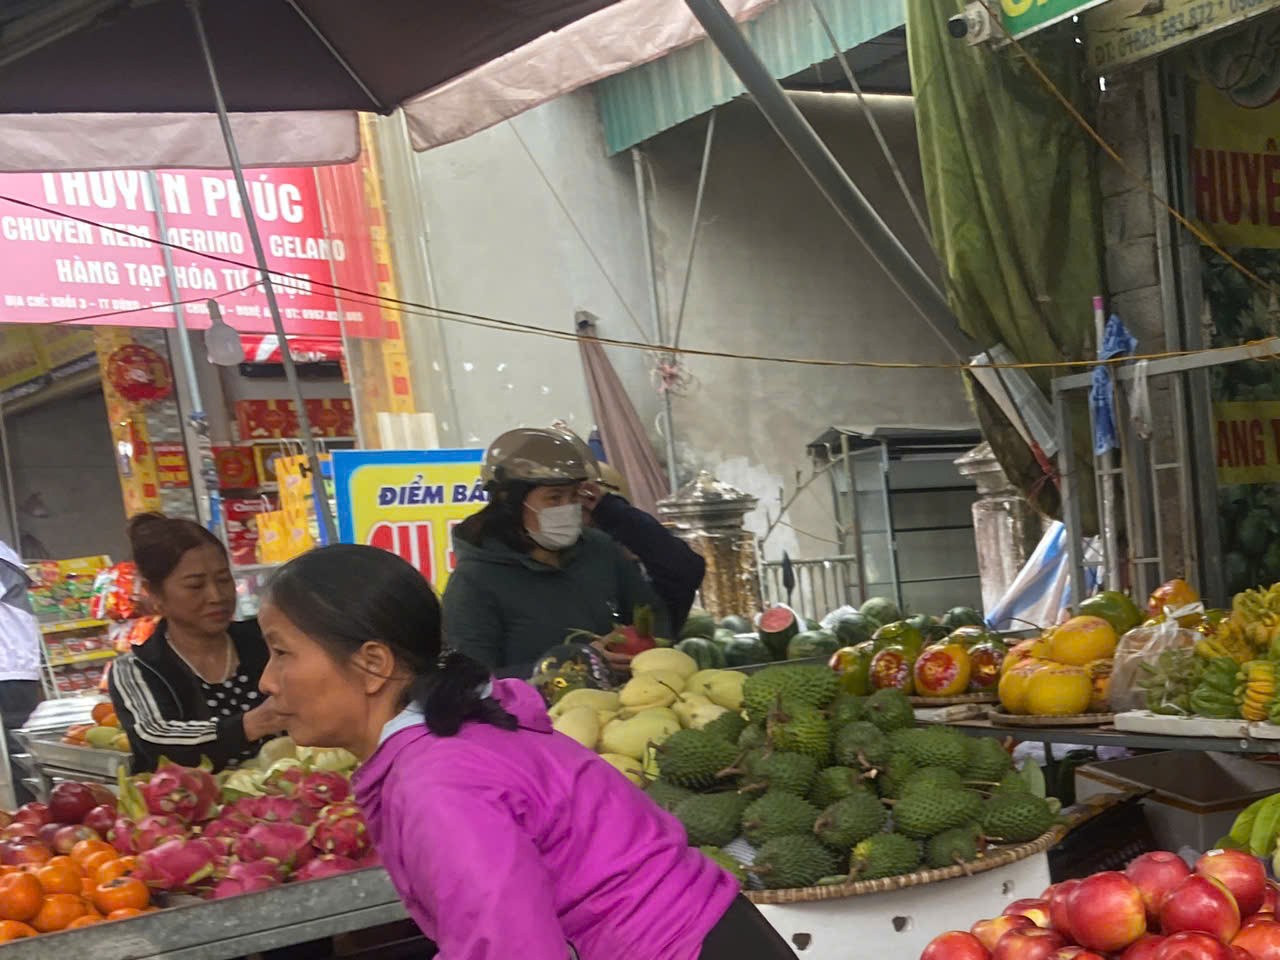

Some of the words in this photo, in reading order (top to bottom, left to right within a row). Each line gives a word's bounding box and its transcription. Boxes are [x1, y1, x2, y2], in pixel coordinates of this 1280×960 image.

[200, 174, 304, 224] PHÚC
[268, 234, 346, 262] CELANO
[55, 255, 121, 286] HÀNG
[123, 262, 167, 292] TẠP
[173, 262, 218, 291] HÓA
[1216, 417, 1267, 468] ANG
[377, 474, 445, 506] ĐIỂM
[451, 478, 492, 503] BÁ
